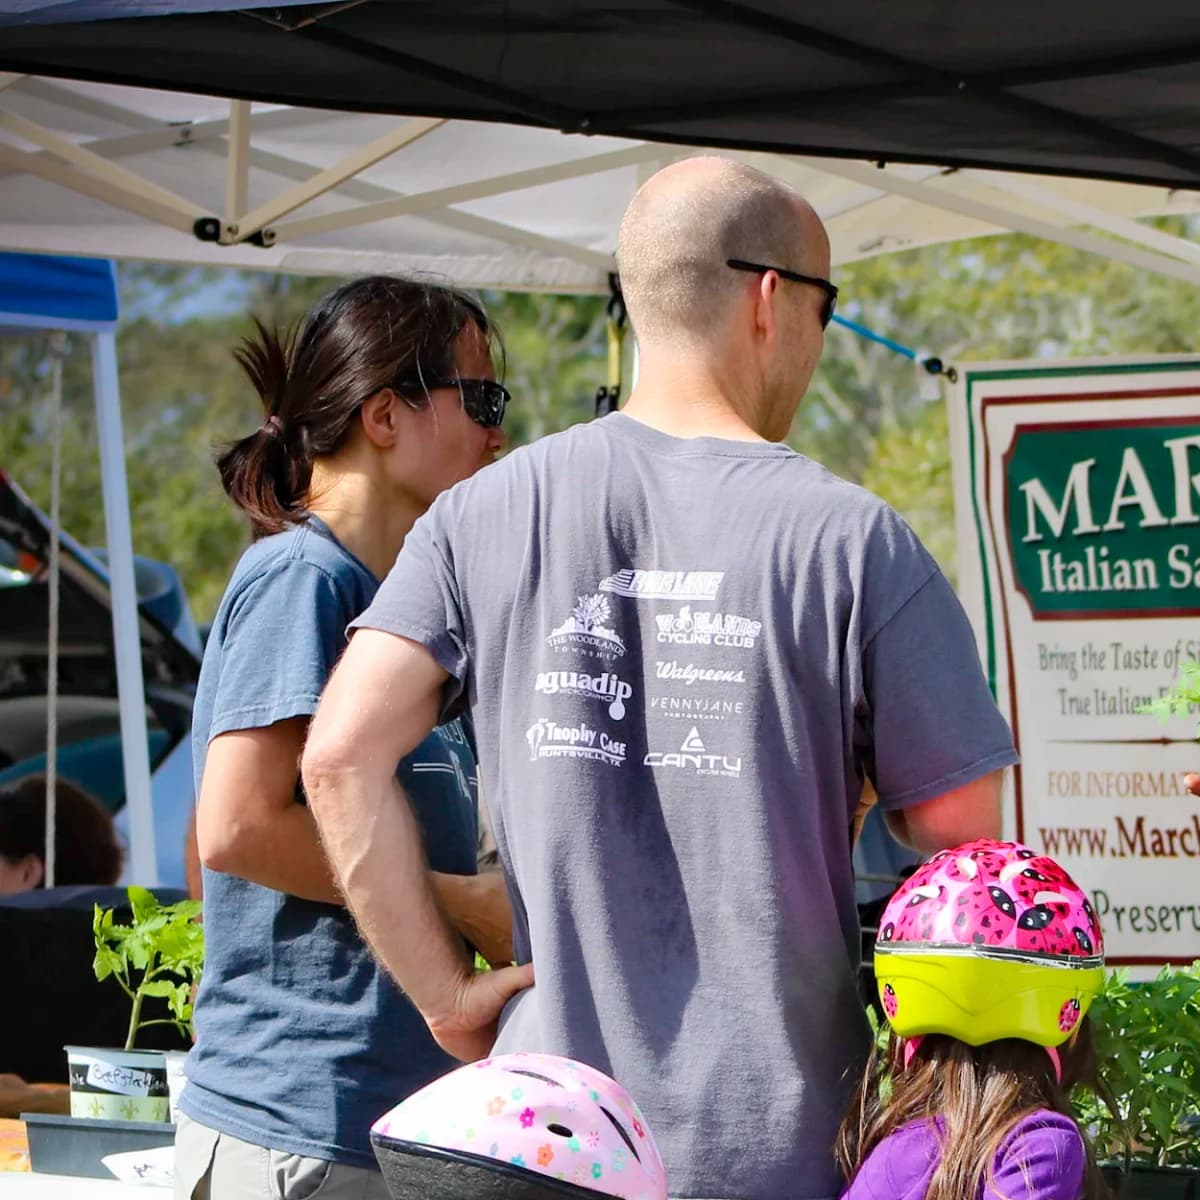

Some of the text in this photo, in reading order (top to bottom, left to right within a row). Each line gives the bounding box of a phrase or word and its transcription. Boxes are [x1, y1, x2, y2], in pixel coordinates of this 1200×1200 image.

[1037, 546, 1159, 593] Italian
[567, 634, 626, 658] WOODLANDS
[656, 632, 756, 649] CYCLING CLUB
[655, 660, 747, 685] Walgreens
[1037, 642, 1079, 682] Bring
[1082, 641, 1107, 672] the
[1110, 641, 1158, 671] Taste
[1163, 638, 1183, 681] of
[1056, 686, 1091, 717] True
[1093, 686, 1153, 717] Italian
[643, 752, 743, 772] CANTU
[1046, 768, 1198, 799] FOR INFORMAT
